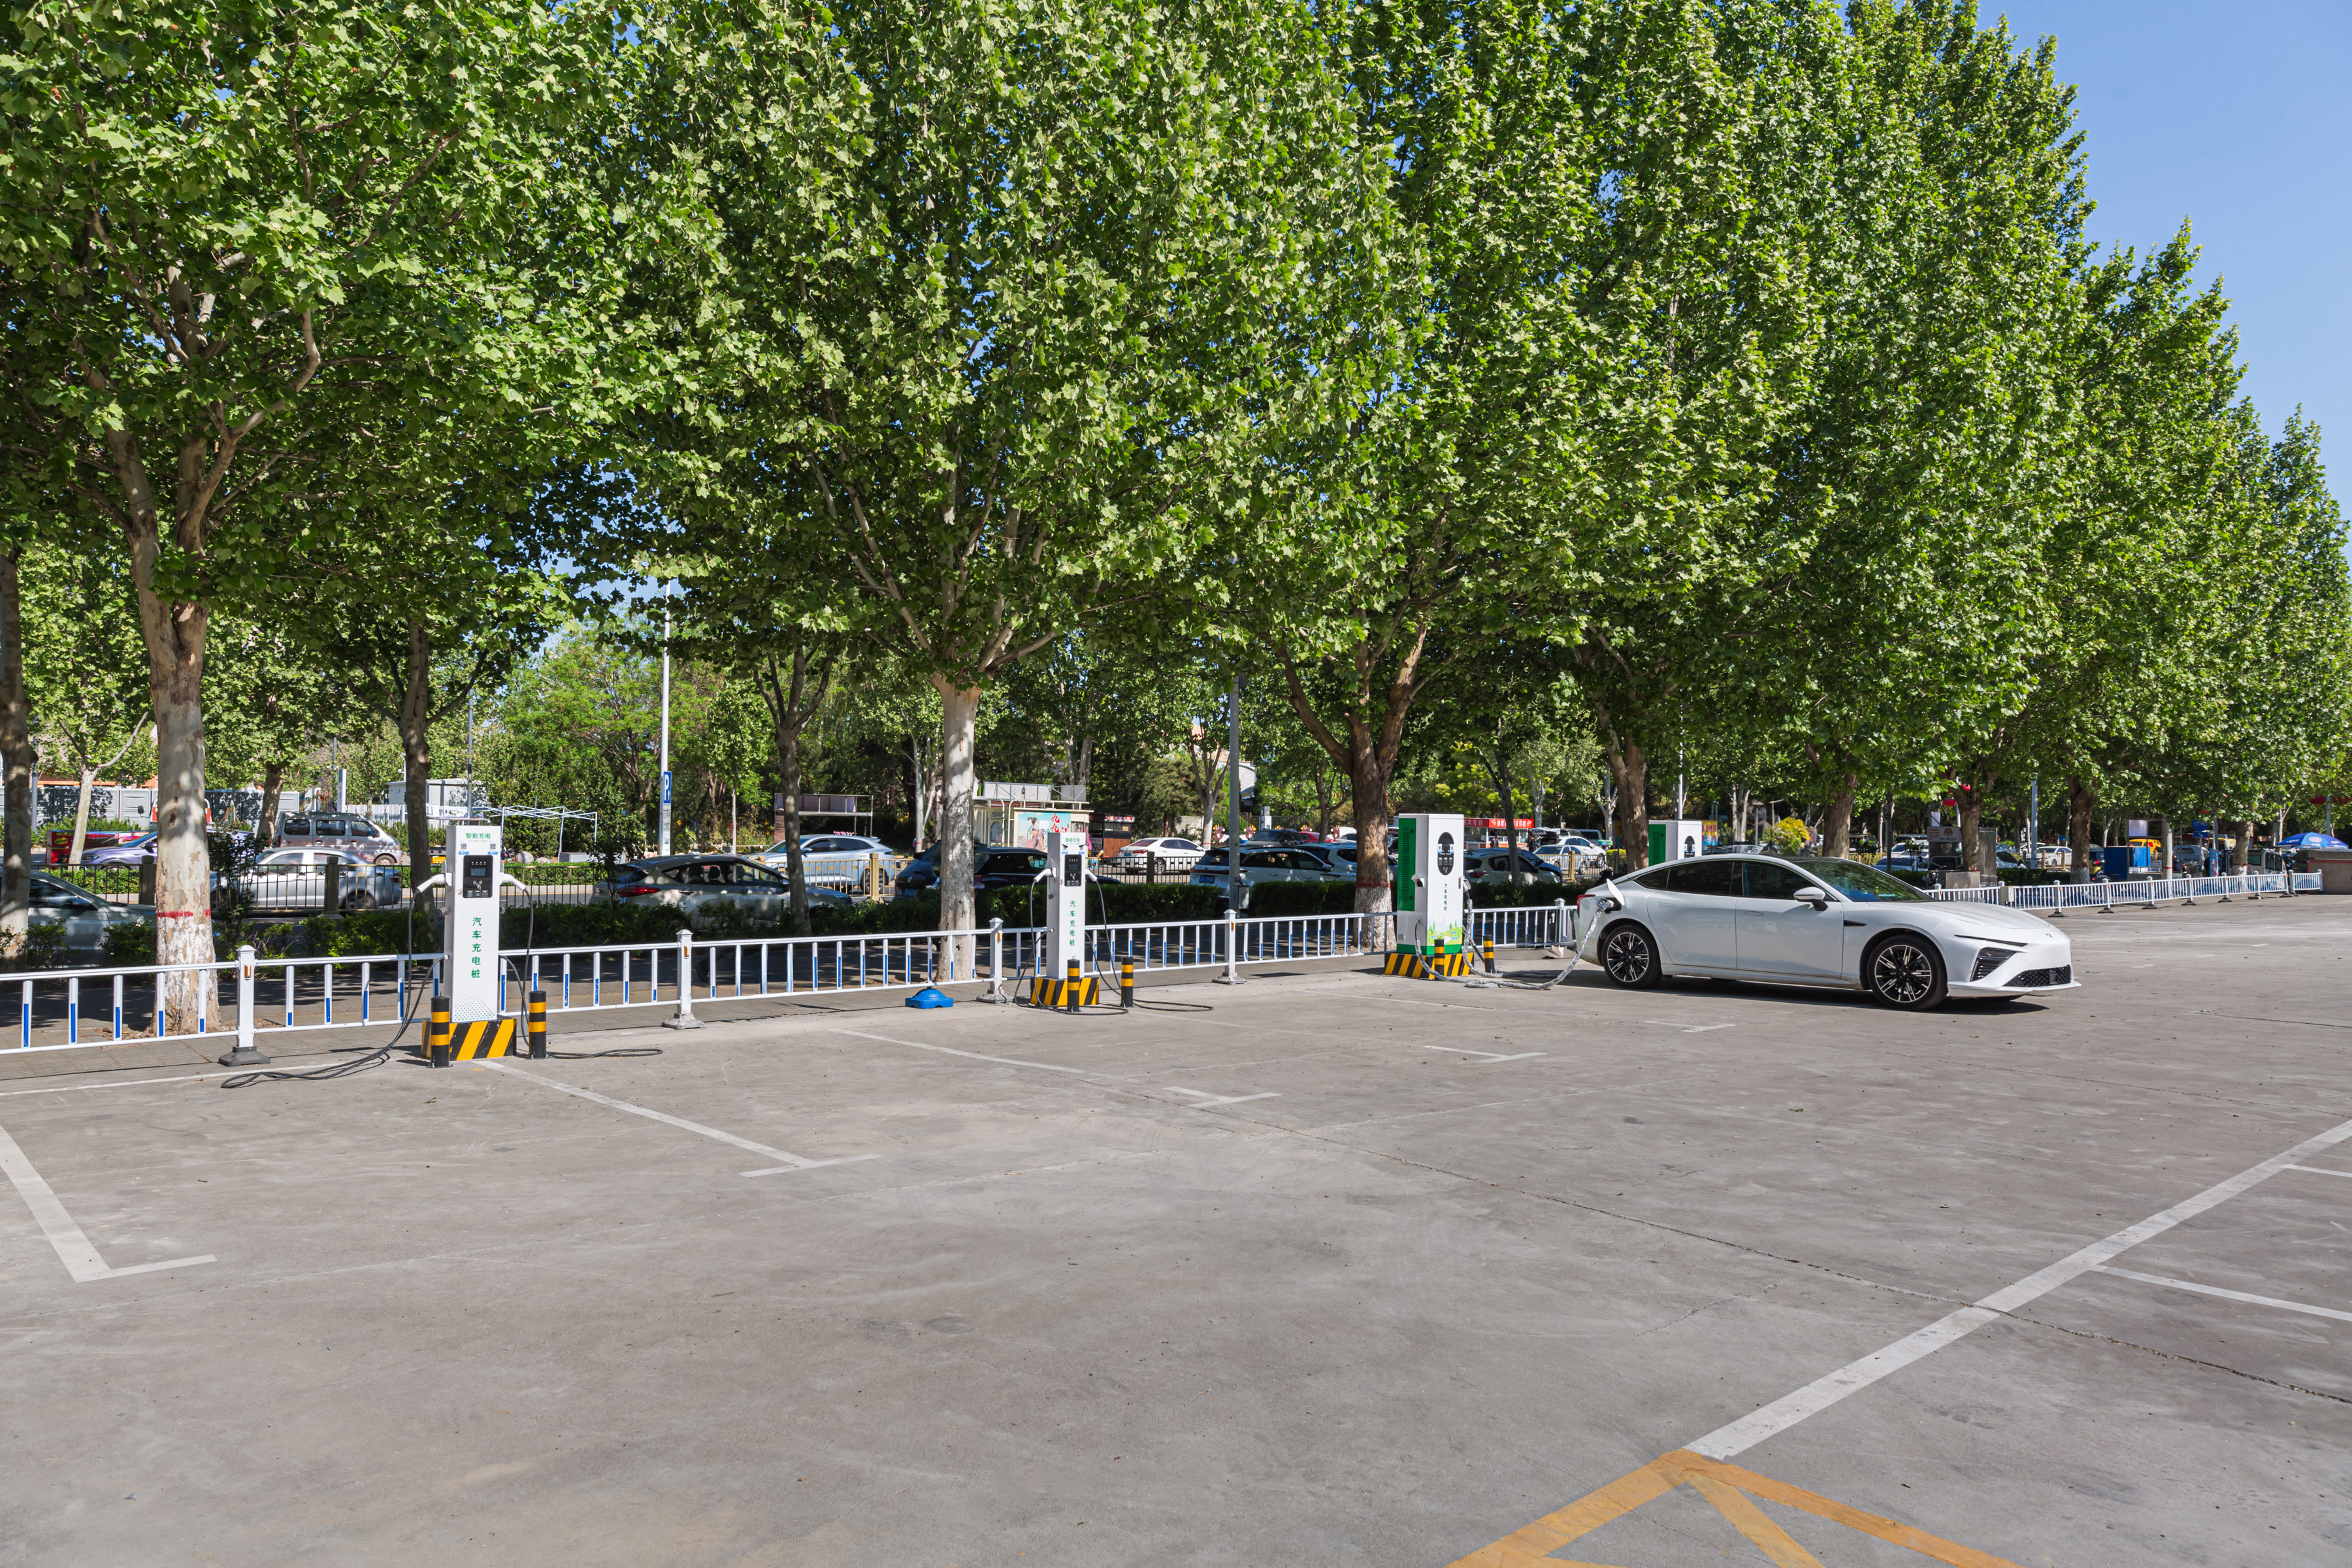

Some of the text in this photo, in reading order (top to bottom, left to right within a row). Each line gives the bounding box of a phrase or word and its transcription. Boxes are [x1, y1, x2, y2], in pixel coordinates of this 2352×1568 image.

[471, 917, 482, 979] 汽车充电桩
